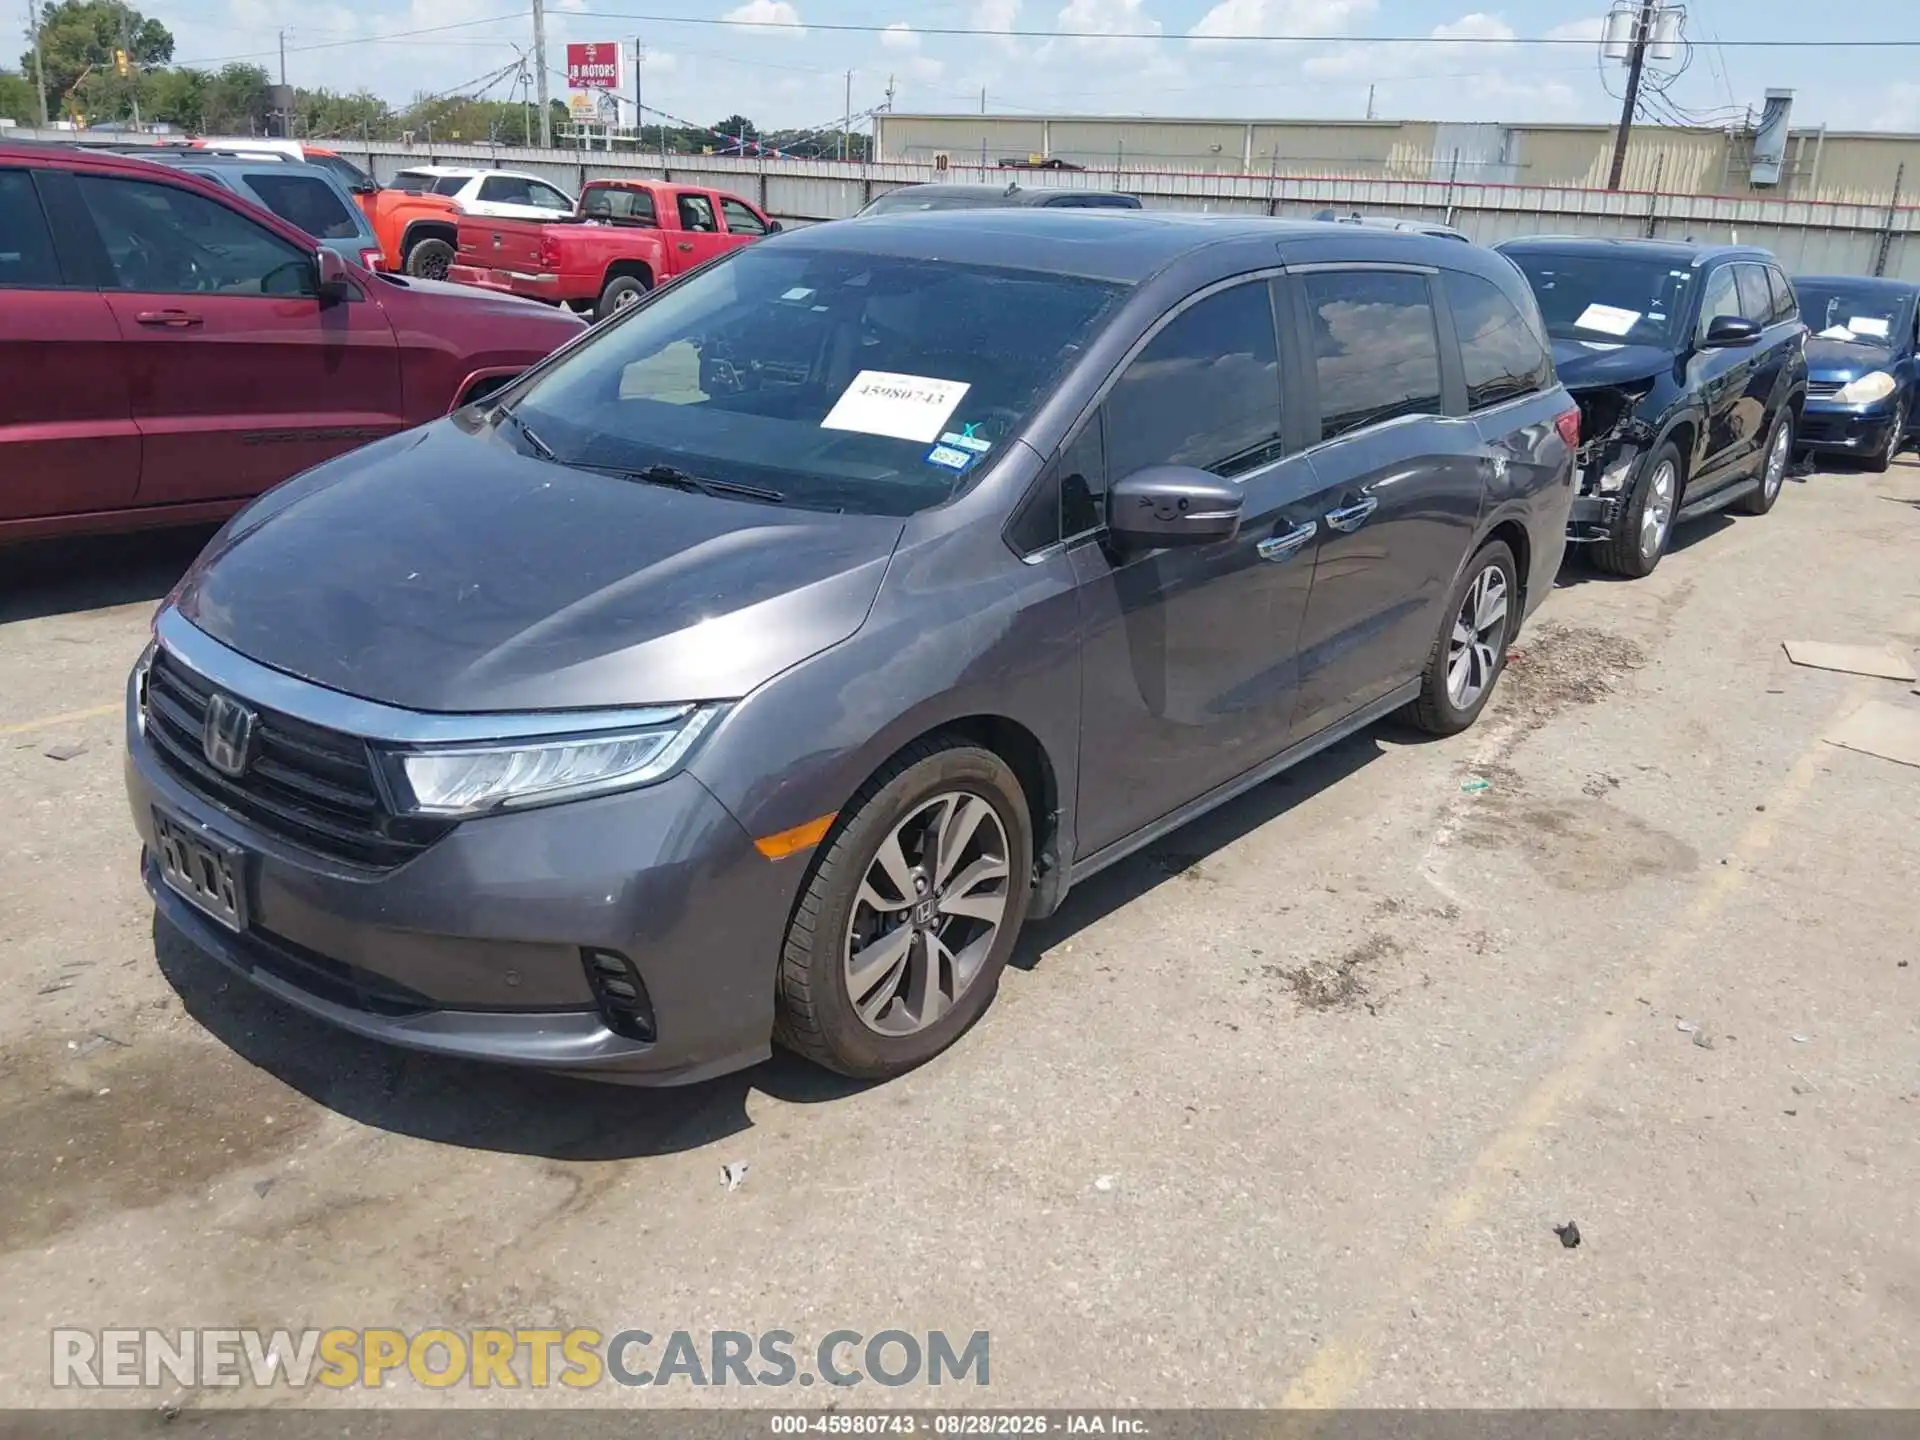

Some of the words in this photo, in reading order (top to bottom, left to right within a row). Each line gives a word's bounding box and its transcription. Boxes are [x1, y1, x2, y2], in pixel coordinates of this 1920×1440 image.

[581, 64, 615, 77] MOTORS
[936, 154, 948, 171] 10
[859, 385, 945, 404] 45980743
